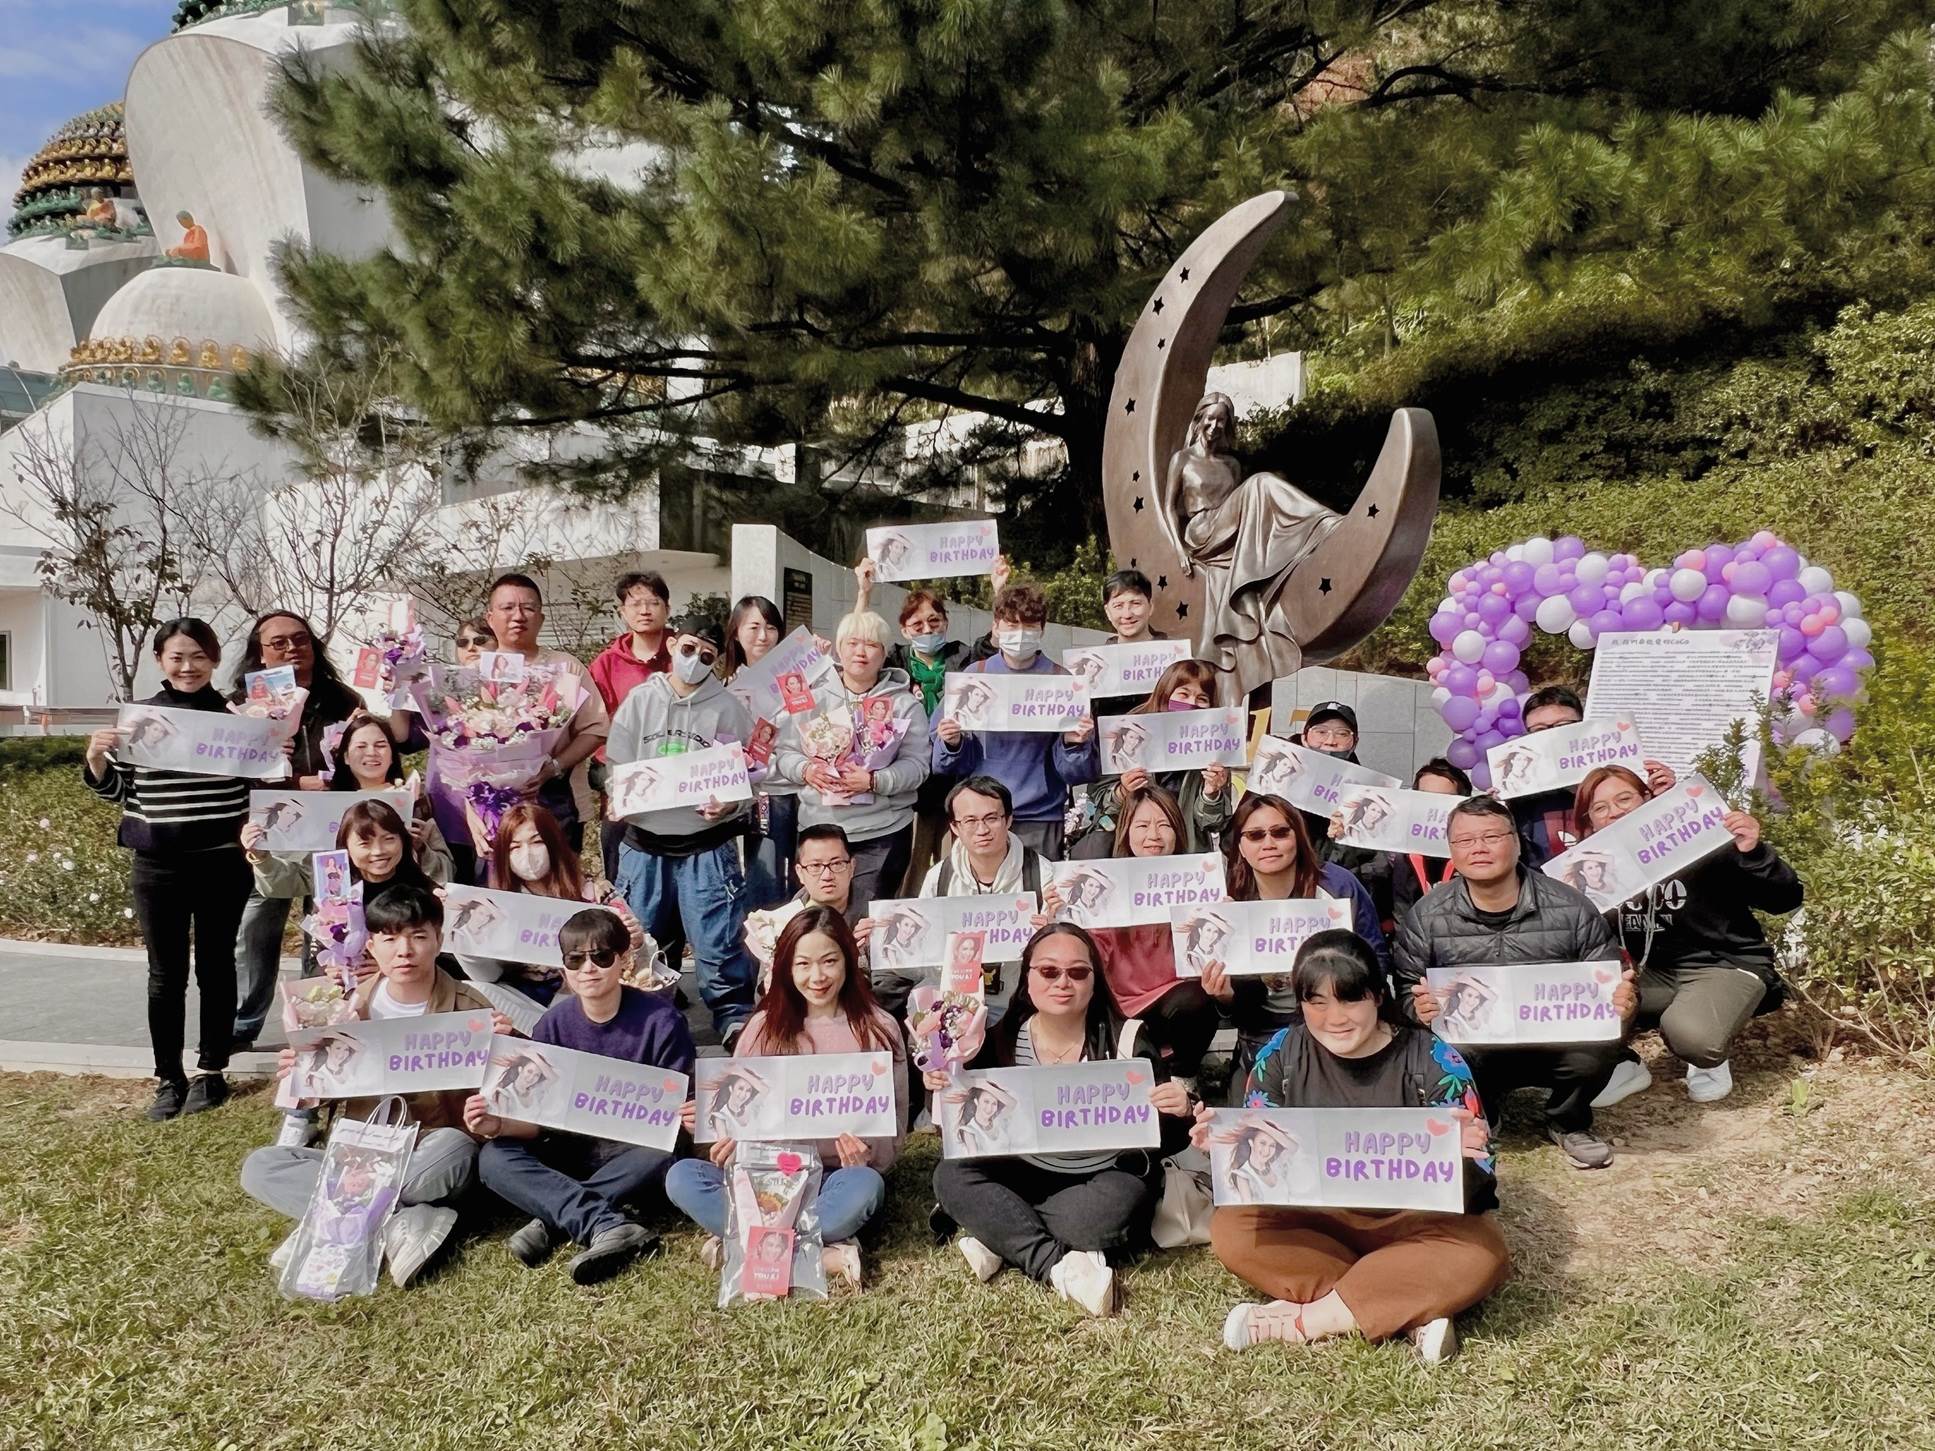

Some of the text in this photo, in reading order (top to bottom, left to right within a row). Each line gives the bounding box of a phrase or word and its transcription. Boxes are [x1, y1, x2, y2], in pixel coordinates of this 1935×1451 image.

[940, 536, 984, 548] HAPPY
[929, 548, 995, 562] BIRTHDAY
[1133, 653, 1176, 667] HAPPY
[1025, 689, 1074, 702] HAPPY
[1012, 703, 1085, 717] BIRTHDAY
[1179, 723, 1229, 739] HAPPY
[196, 742, 279, 762] BIRTHDAY
[1168, 738, 1240, 755] BIRTHDAY
[1569, 731, 1622, 753] HAPPY
[1559, 744, 1638, 769] BIRTHDAY
[690, 759, 735, 778] HAPPY
[678, 771, 747, 793] BIRTHDAY
[1639, 798, 1699, 841] HAPPY
[1638, 806, 1724, 864] BIRTHDAY
[1147, 872, 1206, 889] HAPPY
[1134, 888, 1220, 907] BIRTHDAY
[962, 910, 1019, 928] HAPPY
[1270, 917, 1332, 934] HAPPY
[1535, 982, 1599, 1002] HAPPY
[1519, 1003, 1616, 1022] BIRTHDAY
[404, 1031, 472, 1051] HAPPY
[389, 1050, 489, 1072] BIRTHDAY
[594, 1075, 664, 1103] HAPPY
[807, 1074, 874, 1096] HAPPY
[1057, 1083, 1130, 1105] HAPPY
[574, 1092, 676, 1127] BIRTHDAY
[790, 1096, 889, 1117] BIRTHDAY
[1041, 1105, 1150, 1128] BIRTHDAY
[1345, 1130, 1431, 1156] HAPPY
[1326, 1157, 1454, 1183] BIRTHDAY
